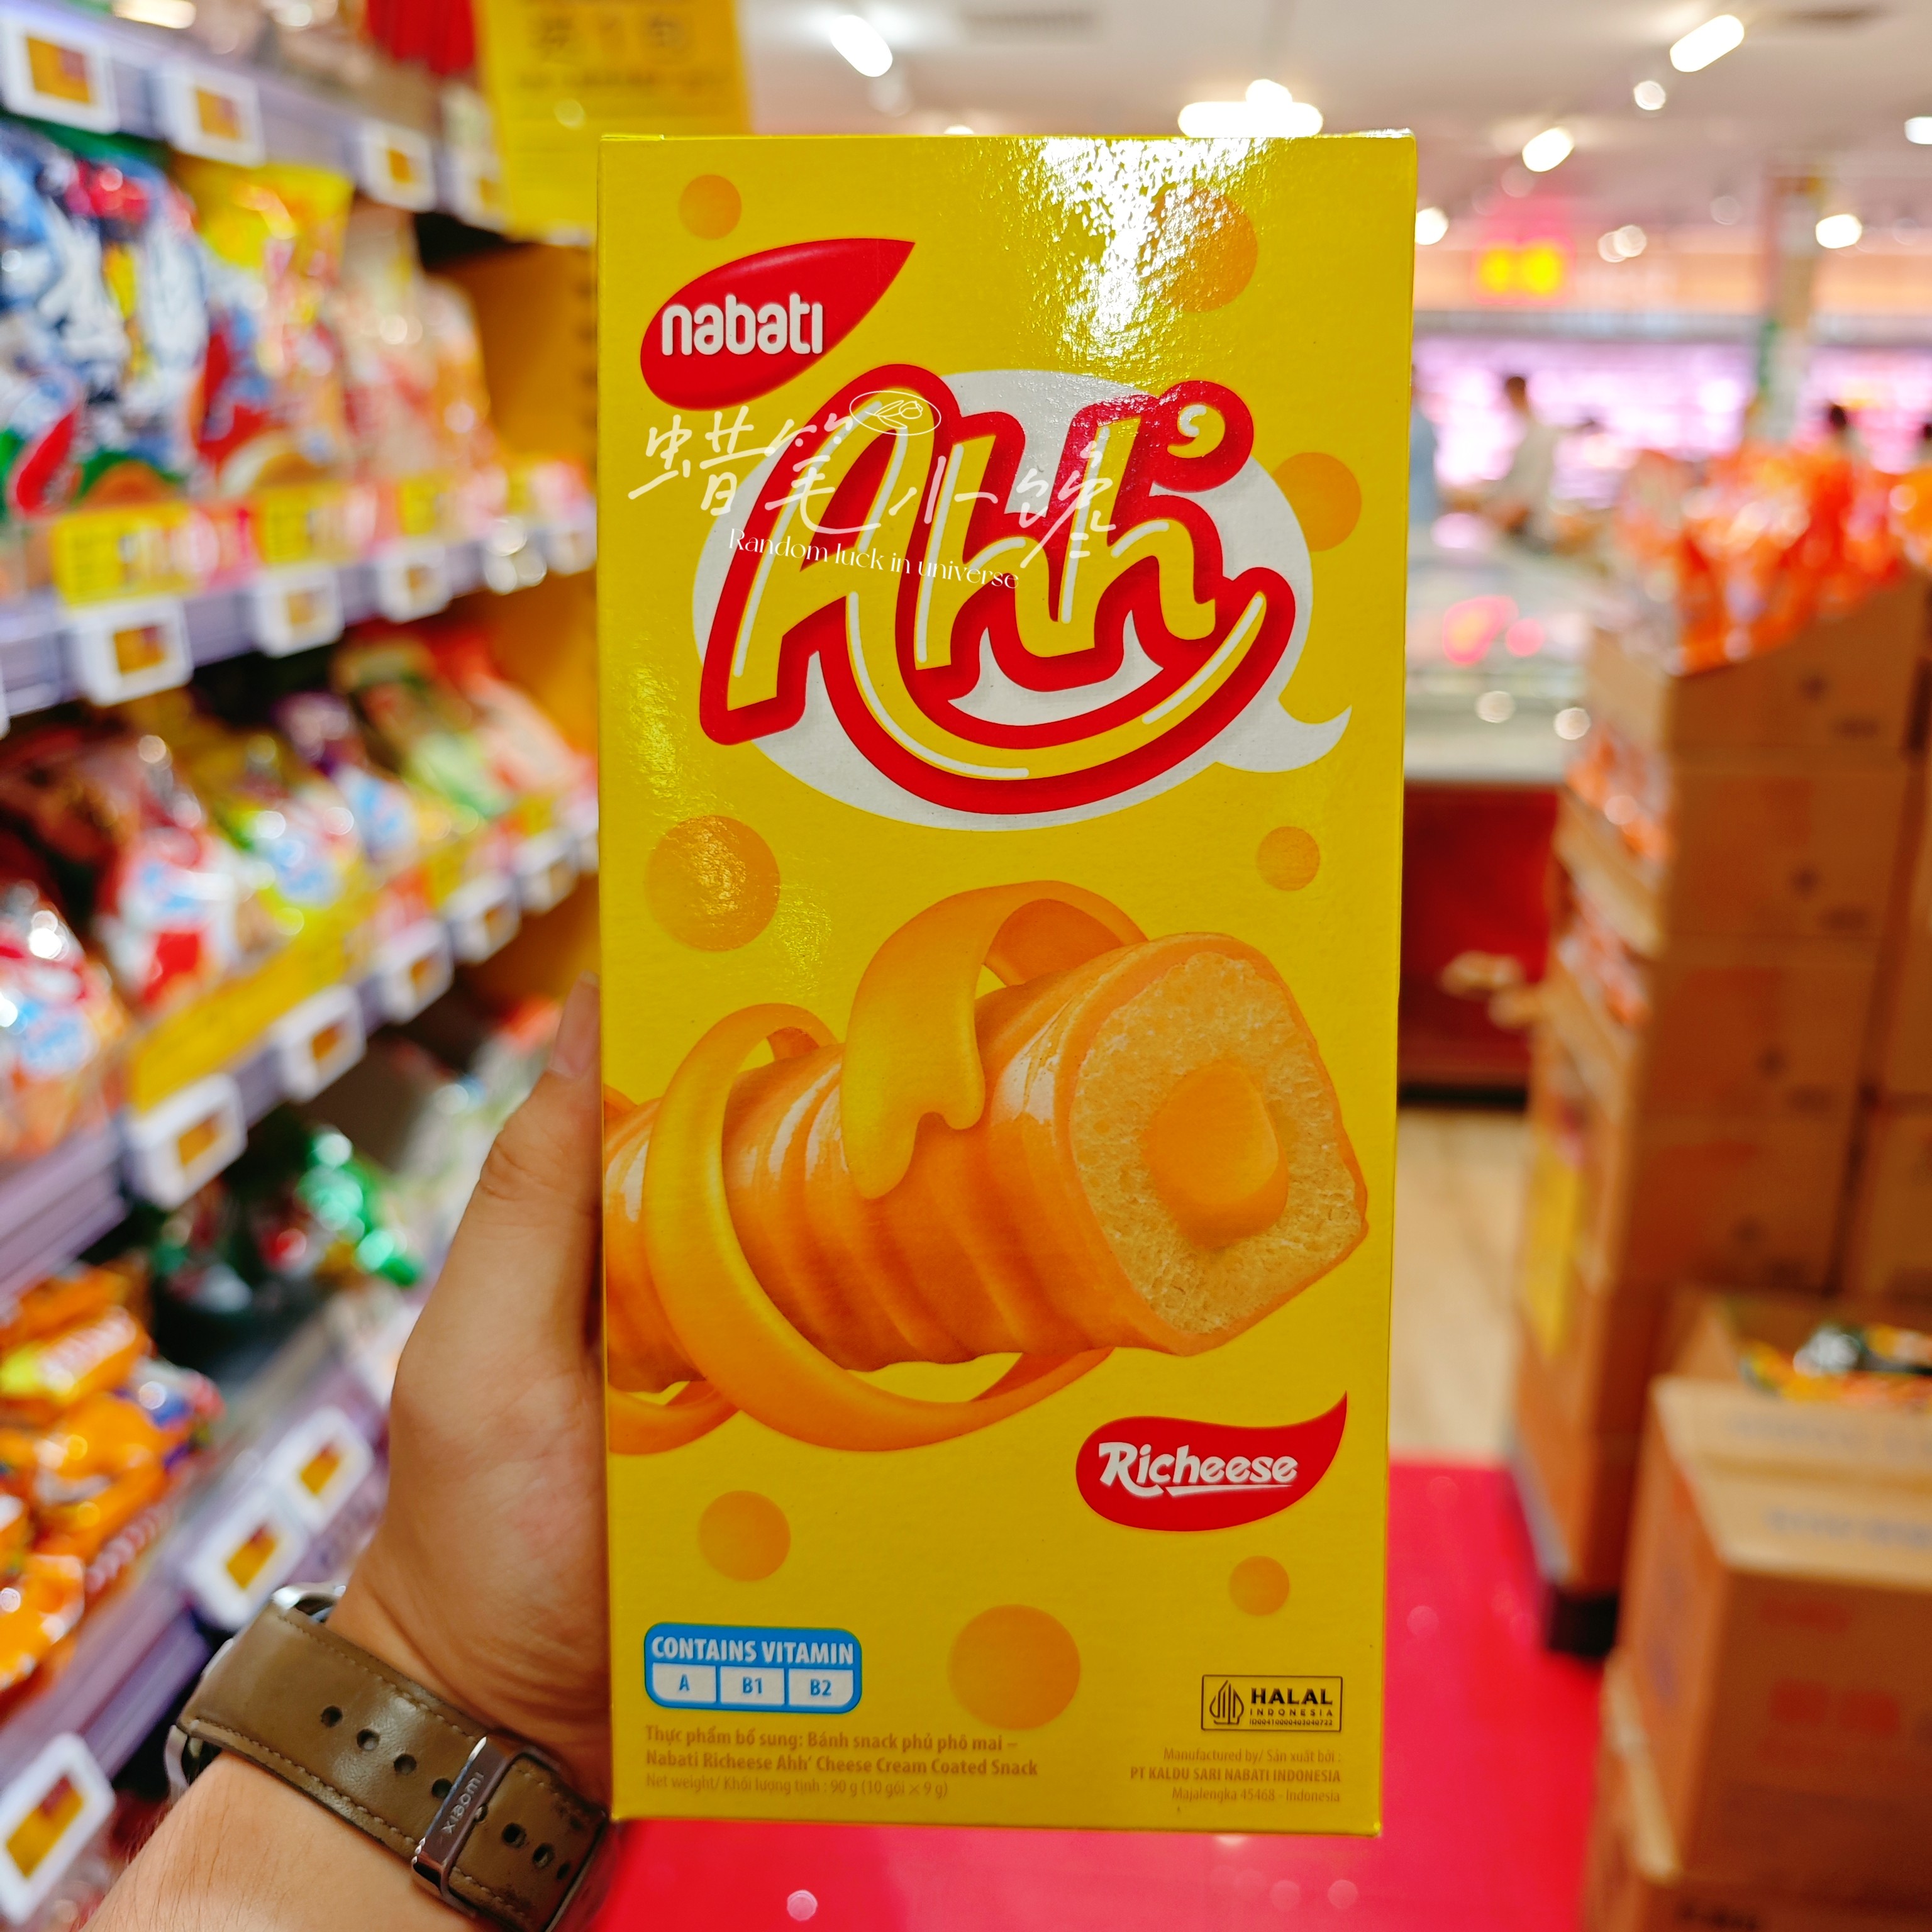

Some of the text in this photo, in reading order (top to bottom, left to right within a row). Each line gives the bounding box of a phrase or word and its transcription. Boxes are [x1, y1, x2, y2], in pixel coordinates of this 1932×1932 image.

[662, 293, 823, 356] nabati
[1099, 1441, 1298, 1497] Richeese
[652, 1636, 854, 1665] CONTAINS VITAMIN
[679, 1674, 831, 1696] A B1 B2
[1250, 1687, 1333, 1705] HALAL
[1250, 1708, 1333, 1716] INDONESIA
[645, 1724, 682, 1746] Thực
[760, 1733, 803, 1751] sung:
[808, 1730, 848, 1747] Bánh
[853, 1733, 897, 1748] snack
[937, 1733, 968, 1754] phô
[972, 1735, 1002, 1751] mai
[647, 1750, 699, 1767] Nabati
[704, 1752, 772, 1770] Richeese
[817, 1755, 872, 1772] Cheese
[877, 1757, 927, 1774] Cream
[931, 1758, 987, 1775] Coated
[991, 1759, 1038, 1775] Snack
[1163, 1747, 1241, 1762] Manufactured
[1245, 1748, 1264, 1765] by/
[646, 1773, 668, 1788] Net
[671, 1775, 721, 1793] weight/
[830, 1779, 847, 1792] 90
[850, 1783, 857, 1797] g
[861, 1779, 882, 1795] (10
[924, 1781, 931, 1795] 9
[935, 1780, 948, 1799] g)
[1131, 1767, 1341, 1782] PT KALDU SARI NABATI INDONESIA
[1172, 1787, 1237, 1803] Majalengka
[1240, 1788, 1275, 1802] 45468
[1286, 1789, 1340, 1802] Indonesia
